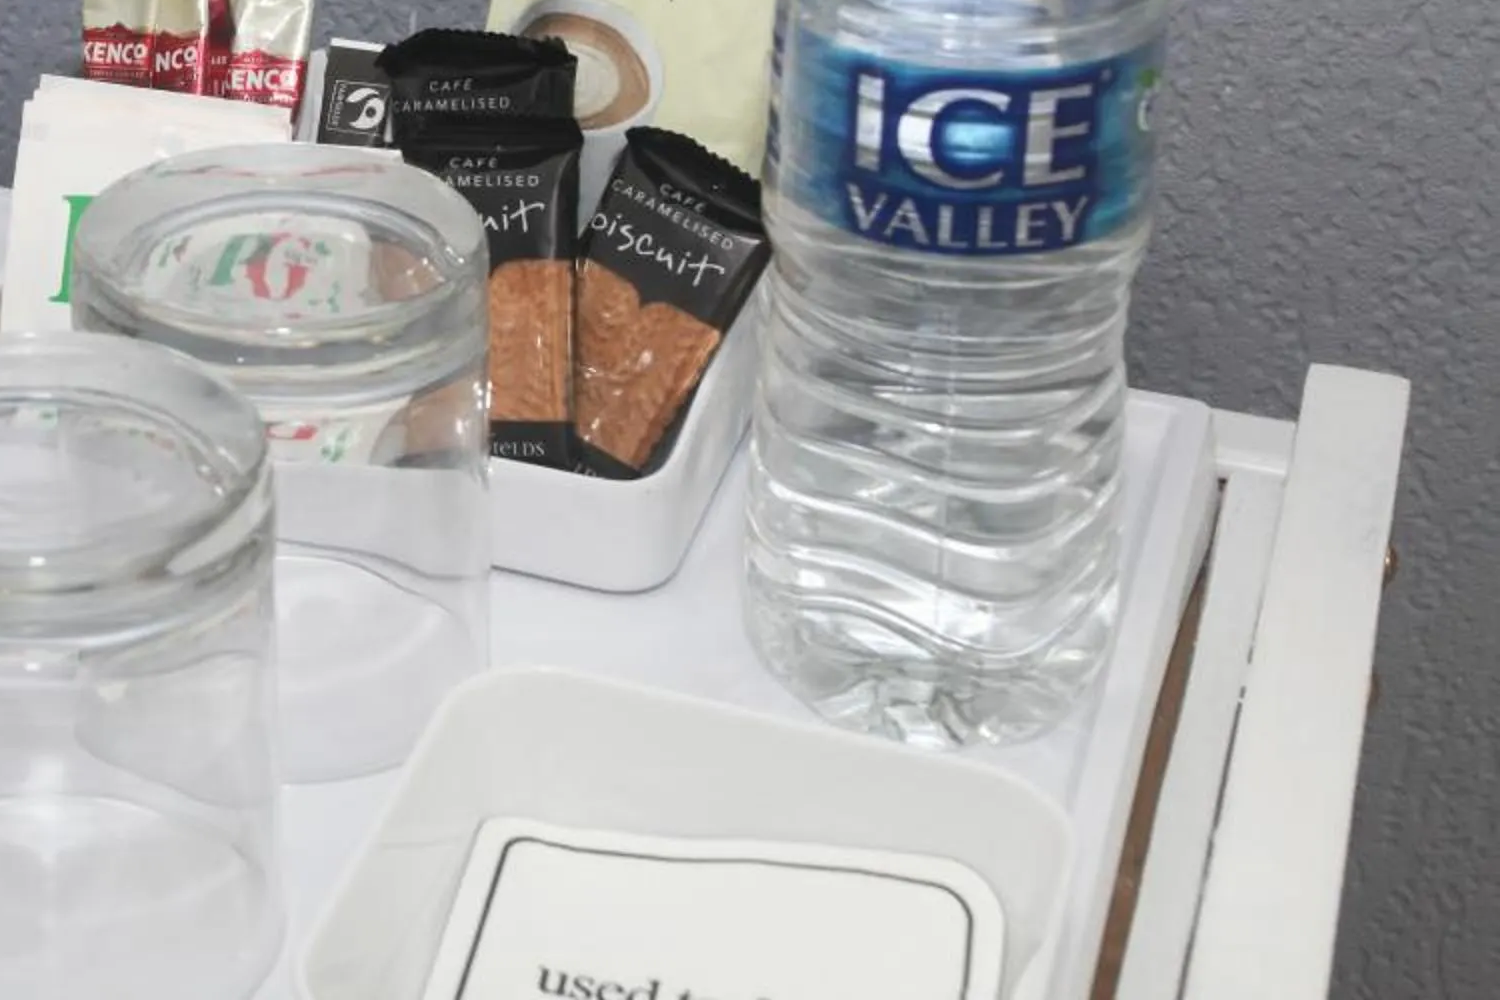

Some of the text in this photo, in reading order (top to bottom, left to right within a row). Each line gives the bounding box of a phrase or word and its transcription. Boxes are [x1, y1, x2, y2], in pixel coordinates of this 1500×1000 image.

[155, 46, 197, 72] NCO
[854, 72, 1094, 190] ICE
[446, 174, 540, 188] AMELISED
[611, 178, 734, 250] CARAMELISED
[846, 182, 1088, 250] VALLEY
[537, 963, 661, 1000] used
